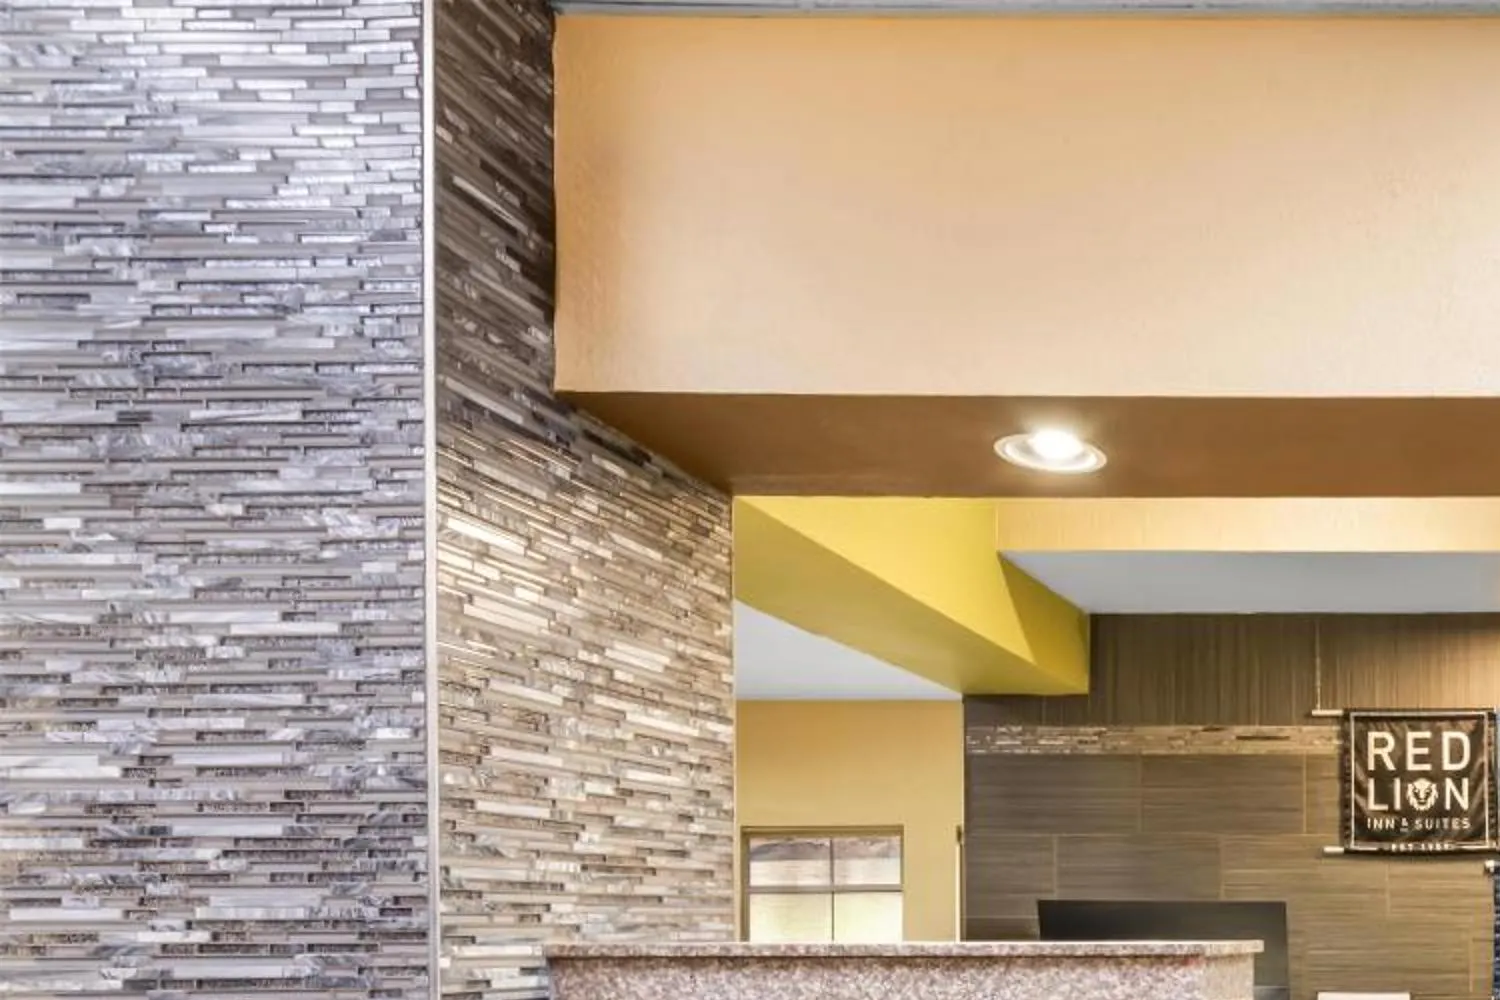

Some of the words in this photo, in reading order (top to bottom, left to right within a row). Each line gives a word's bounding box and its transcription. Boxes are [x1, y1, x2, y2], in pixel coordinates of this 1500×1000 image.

[1367, 731, 1471, 771] RED
[1367, 817, 1396, 829] INN
[1415, 817, 1471, 830] SUITES
